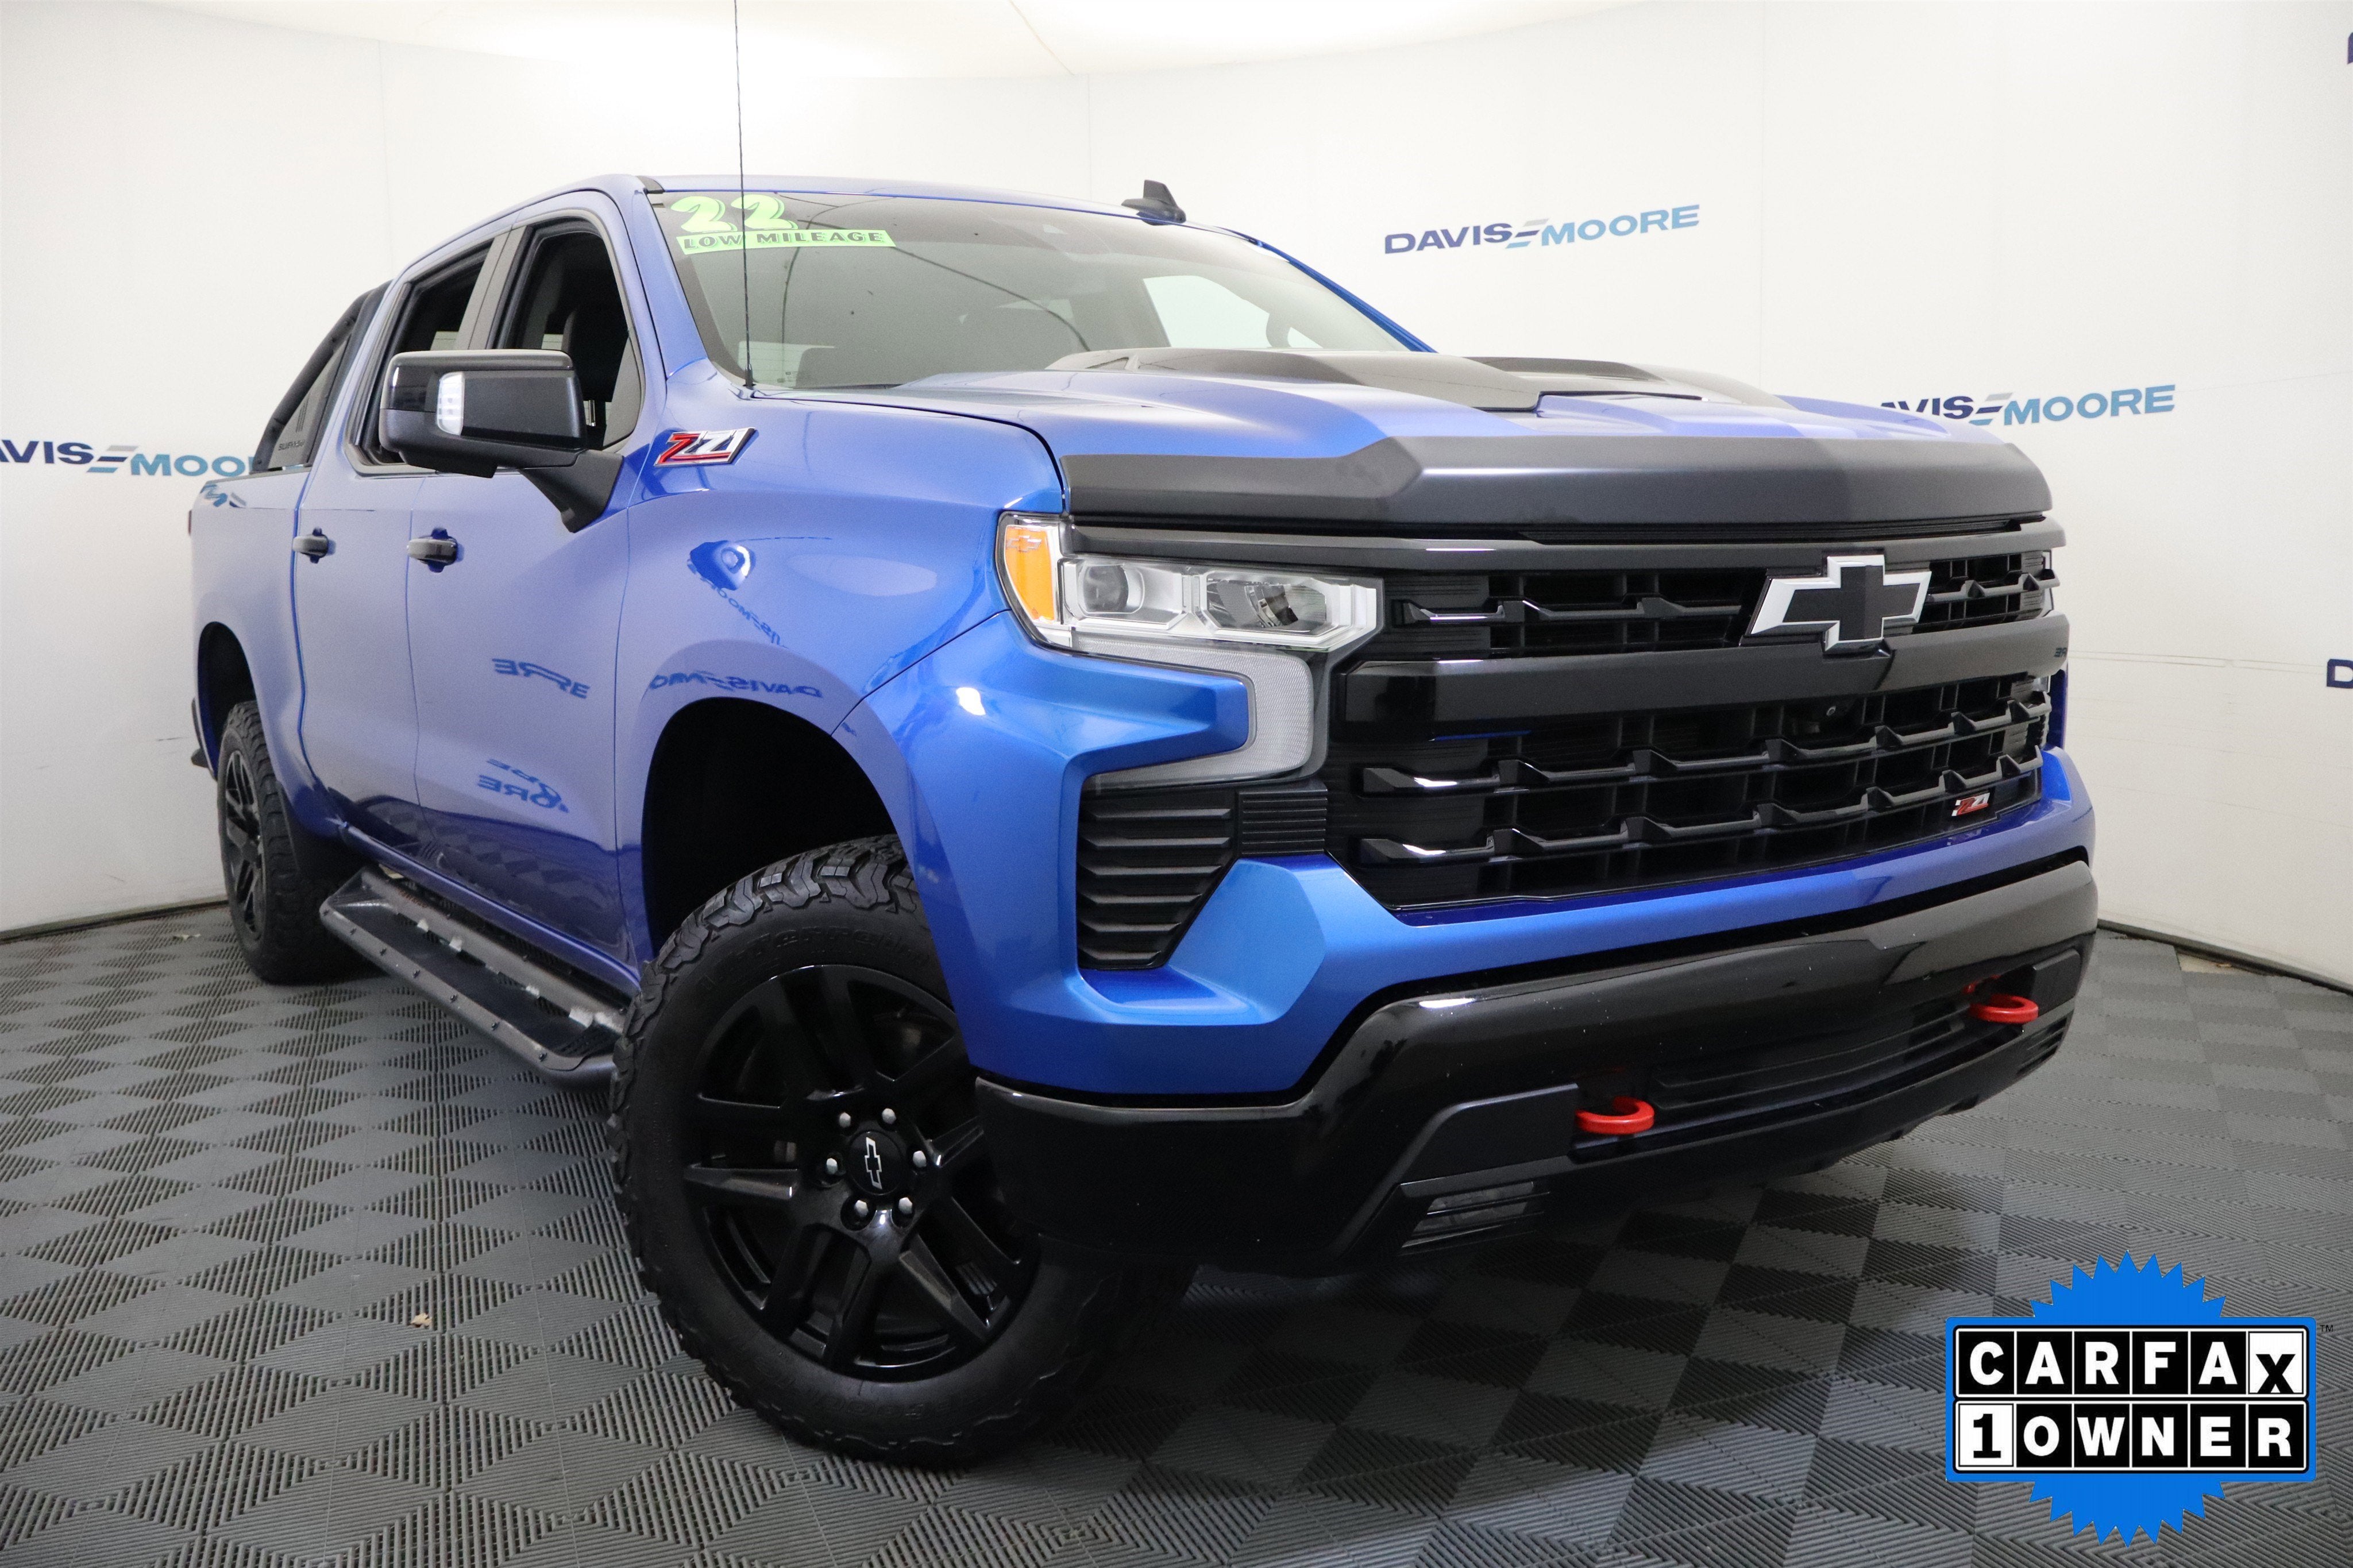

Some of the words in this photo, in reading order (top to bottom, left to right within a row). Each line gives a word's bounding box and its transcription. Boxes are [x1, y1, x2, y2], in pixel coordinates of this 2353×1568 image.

[670, 194, 799, 232] 22
[1385, 223, 1513, 253] DAVIS
[1541, 204, 1699, 246] MOORE
[683, 234, 742, 249] LOW
[757, 231, 886, 244] MILEAGE
[1881, 396, 1974, 419] VIS
[2004, 384, 2175, 425] MOORE
[131, 454, 257, 477] MOO
